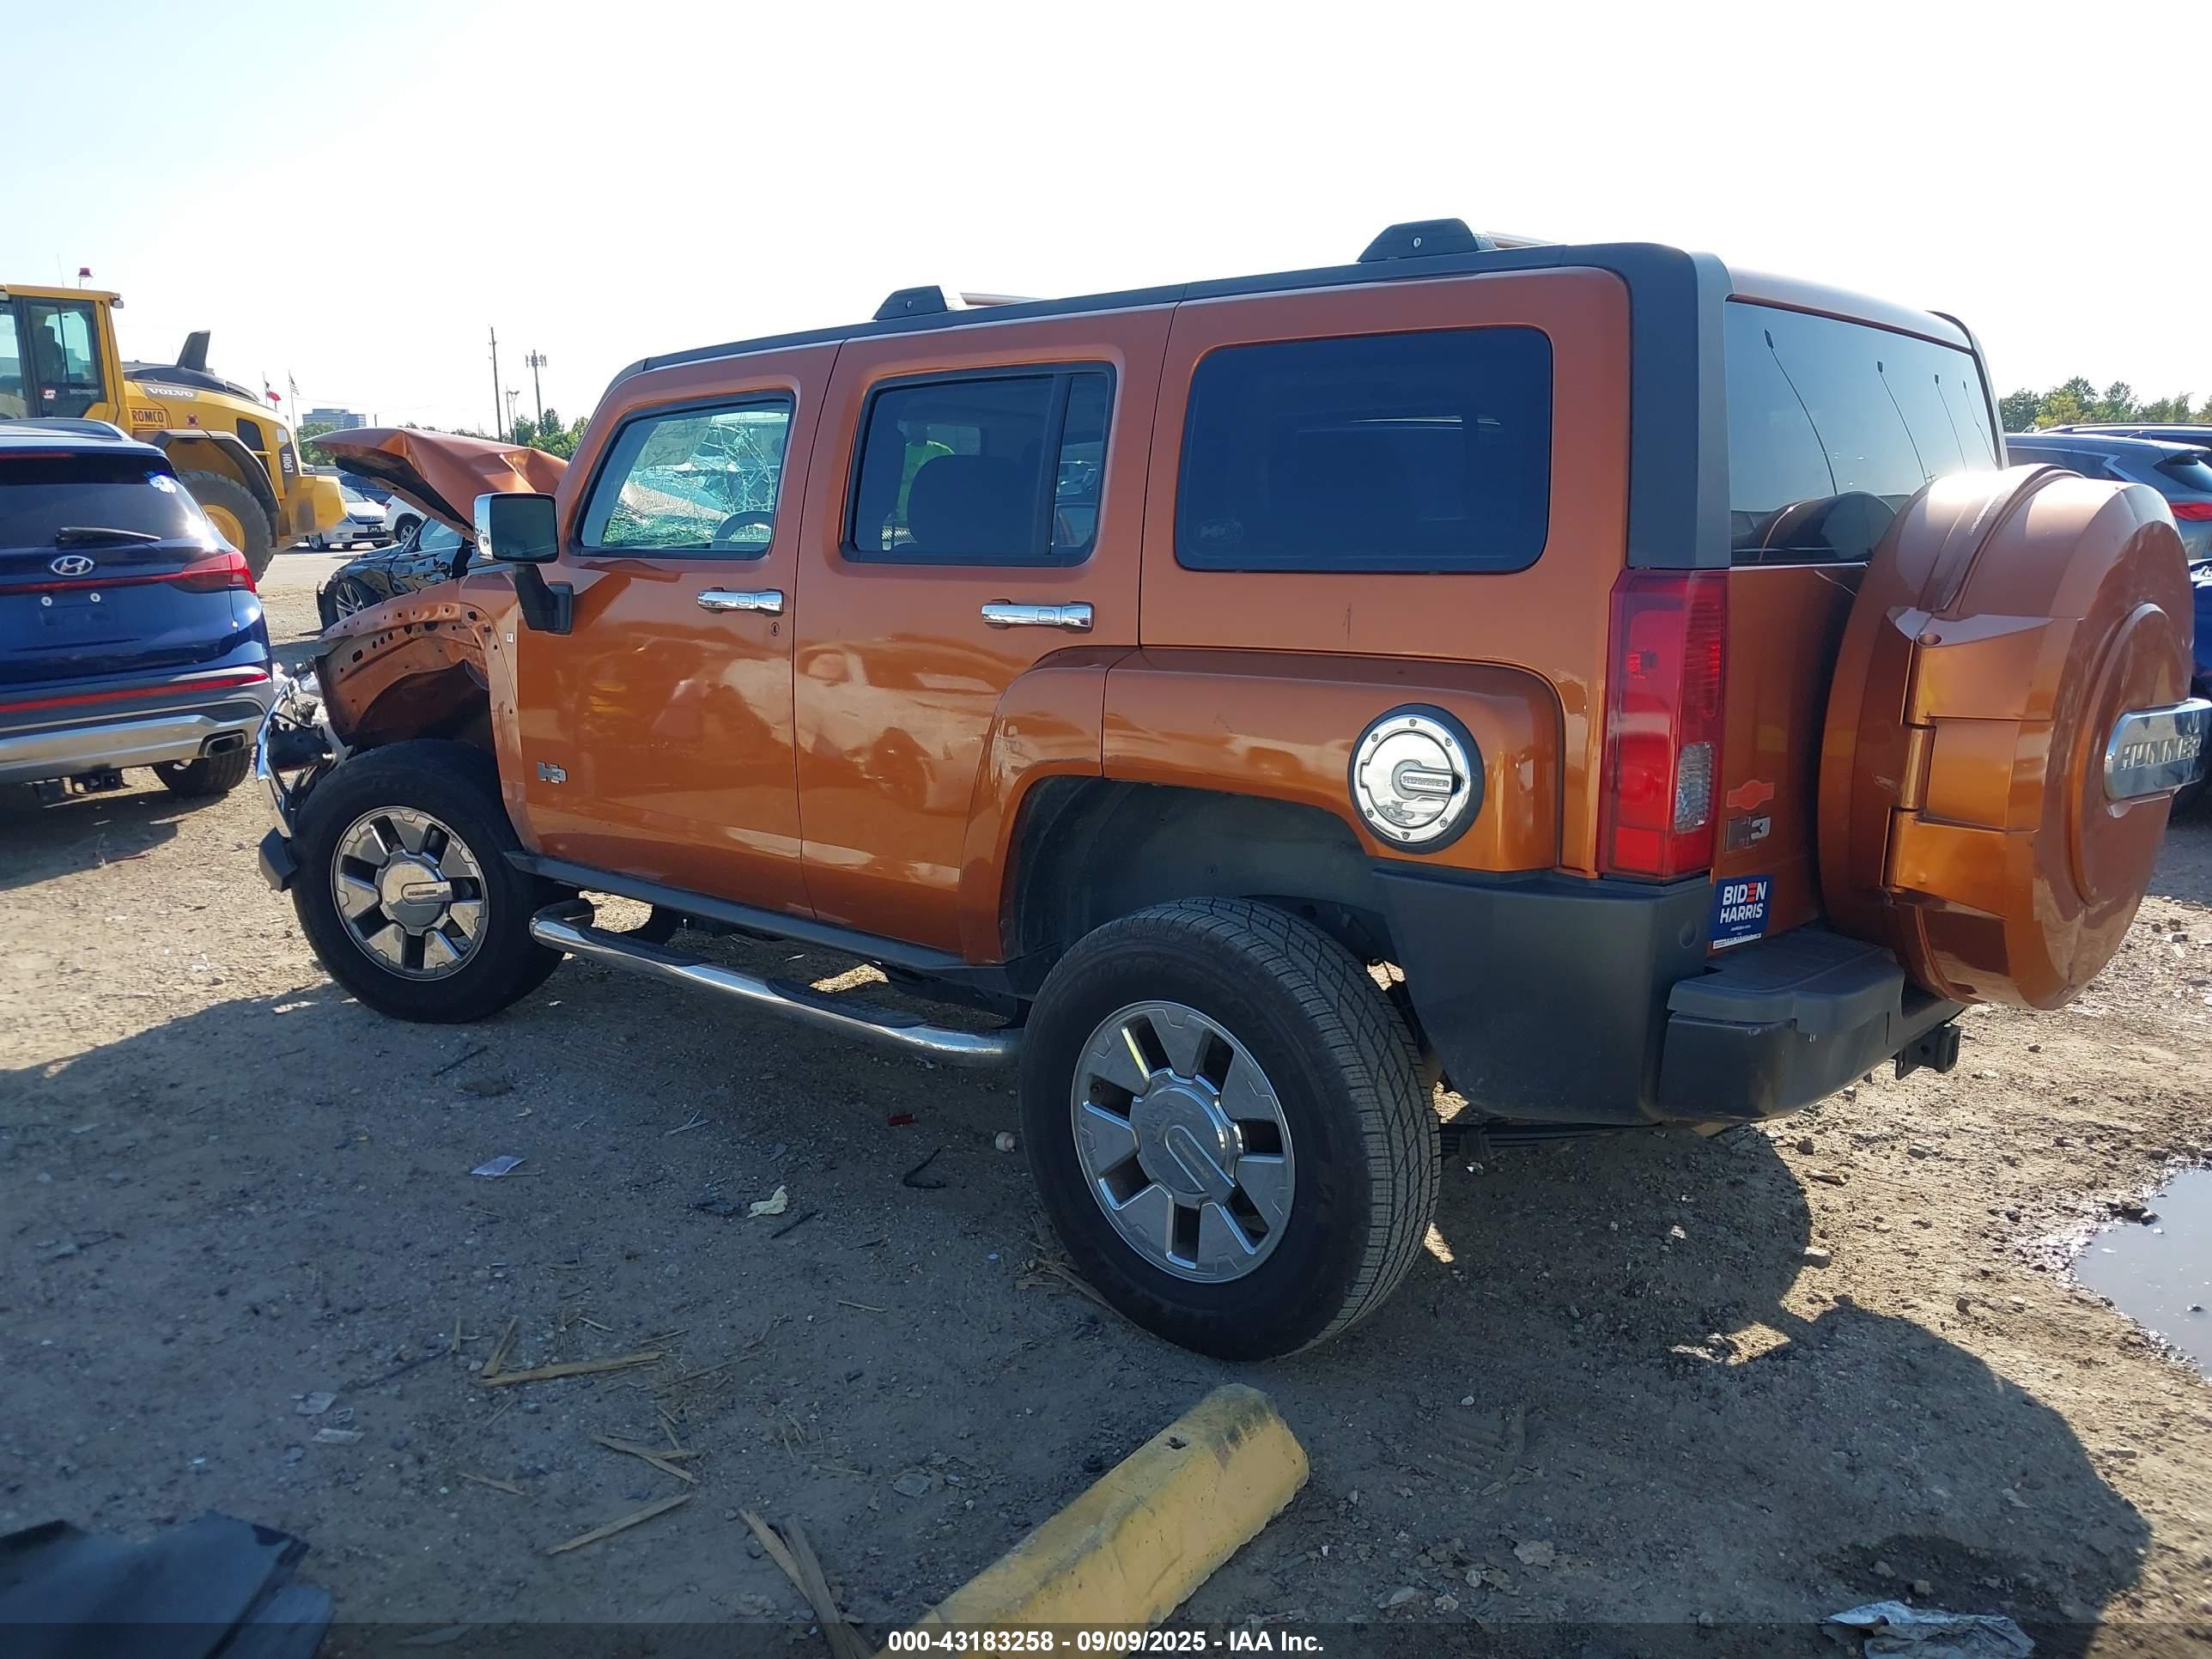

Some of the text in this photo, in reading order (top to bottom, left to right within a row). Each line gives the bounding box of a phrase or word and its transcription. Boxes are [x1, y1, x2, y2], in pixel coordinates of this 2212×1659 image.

[146, 387, 194, 398] VOLVO
[131, 410, 164, 423] ROMCO
[281, 453, 294, 473] L90H
[536, 761, 568, 783] H3
[1722, 881, 1767, 906] BIDEN
[1719, 902, 1764, 924] HARRIS
